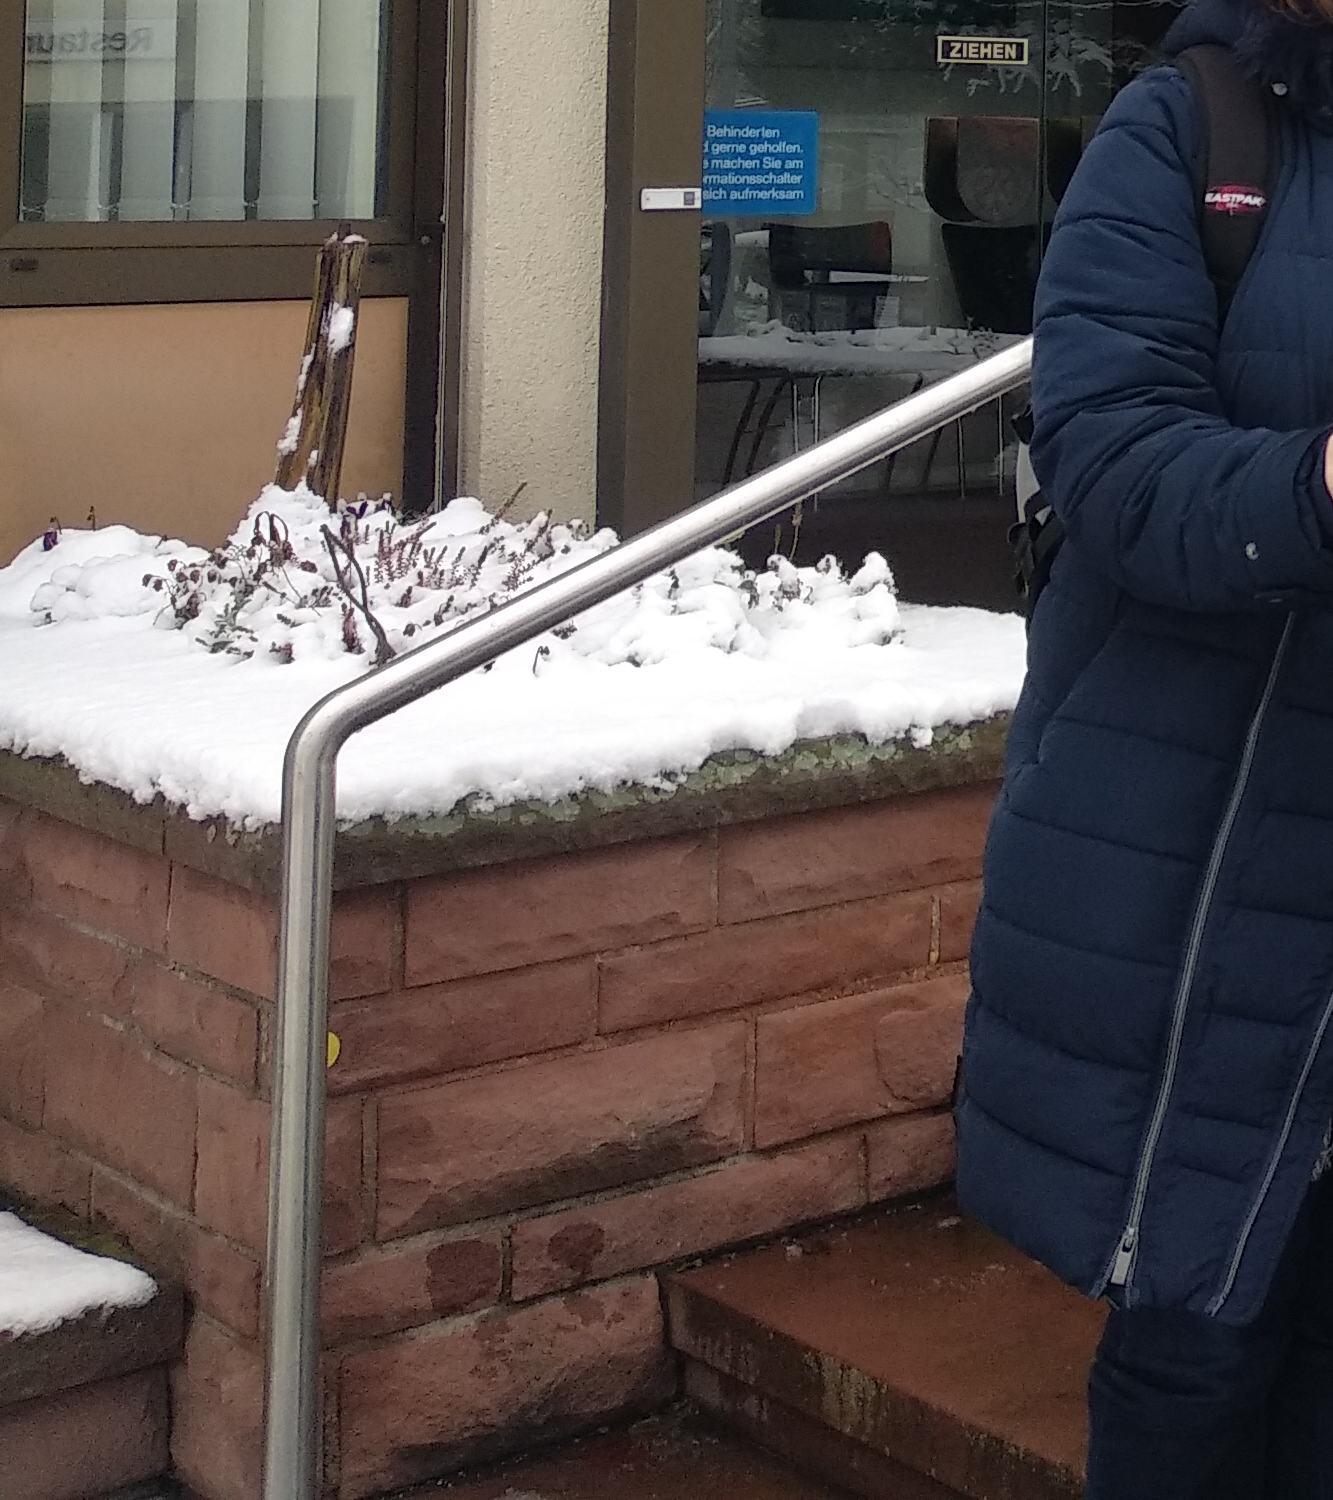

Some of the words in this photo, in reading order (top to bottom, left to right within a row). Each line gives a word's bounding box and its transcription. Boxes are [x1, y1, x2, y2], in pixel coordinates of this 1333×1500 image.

[949, 42, 1017, 59] ZIEHEN
[706, 124, 781, 138] Behinderten
[711, 143, 747, 155] gerne
[749, 141, 804, 156] geholfen.
[711, 157, 760, 170] machen
[762, 157, 782, 170] Sie
[784, 160, 804, 170] am
[729, 187, 805, 201] aufmerksam
[1204, 192, 1263, 207] EASTPAK
